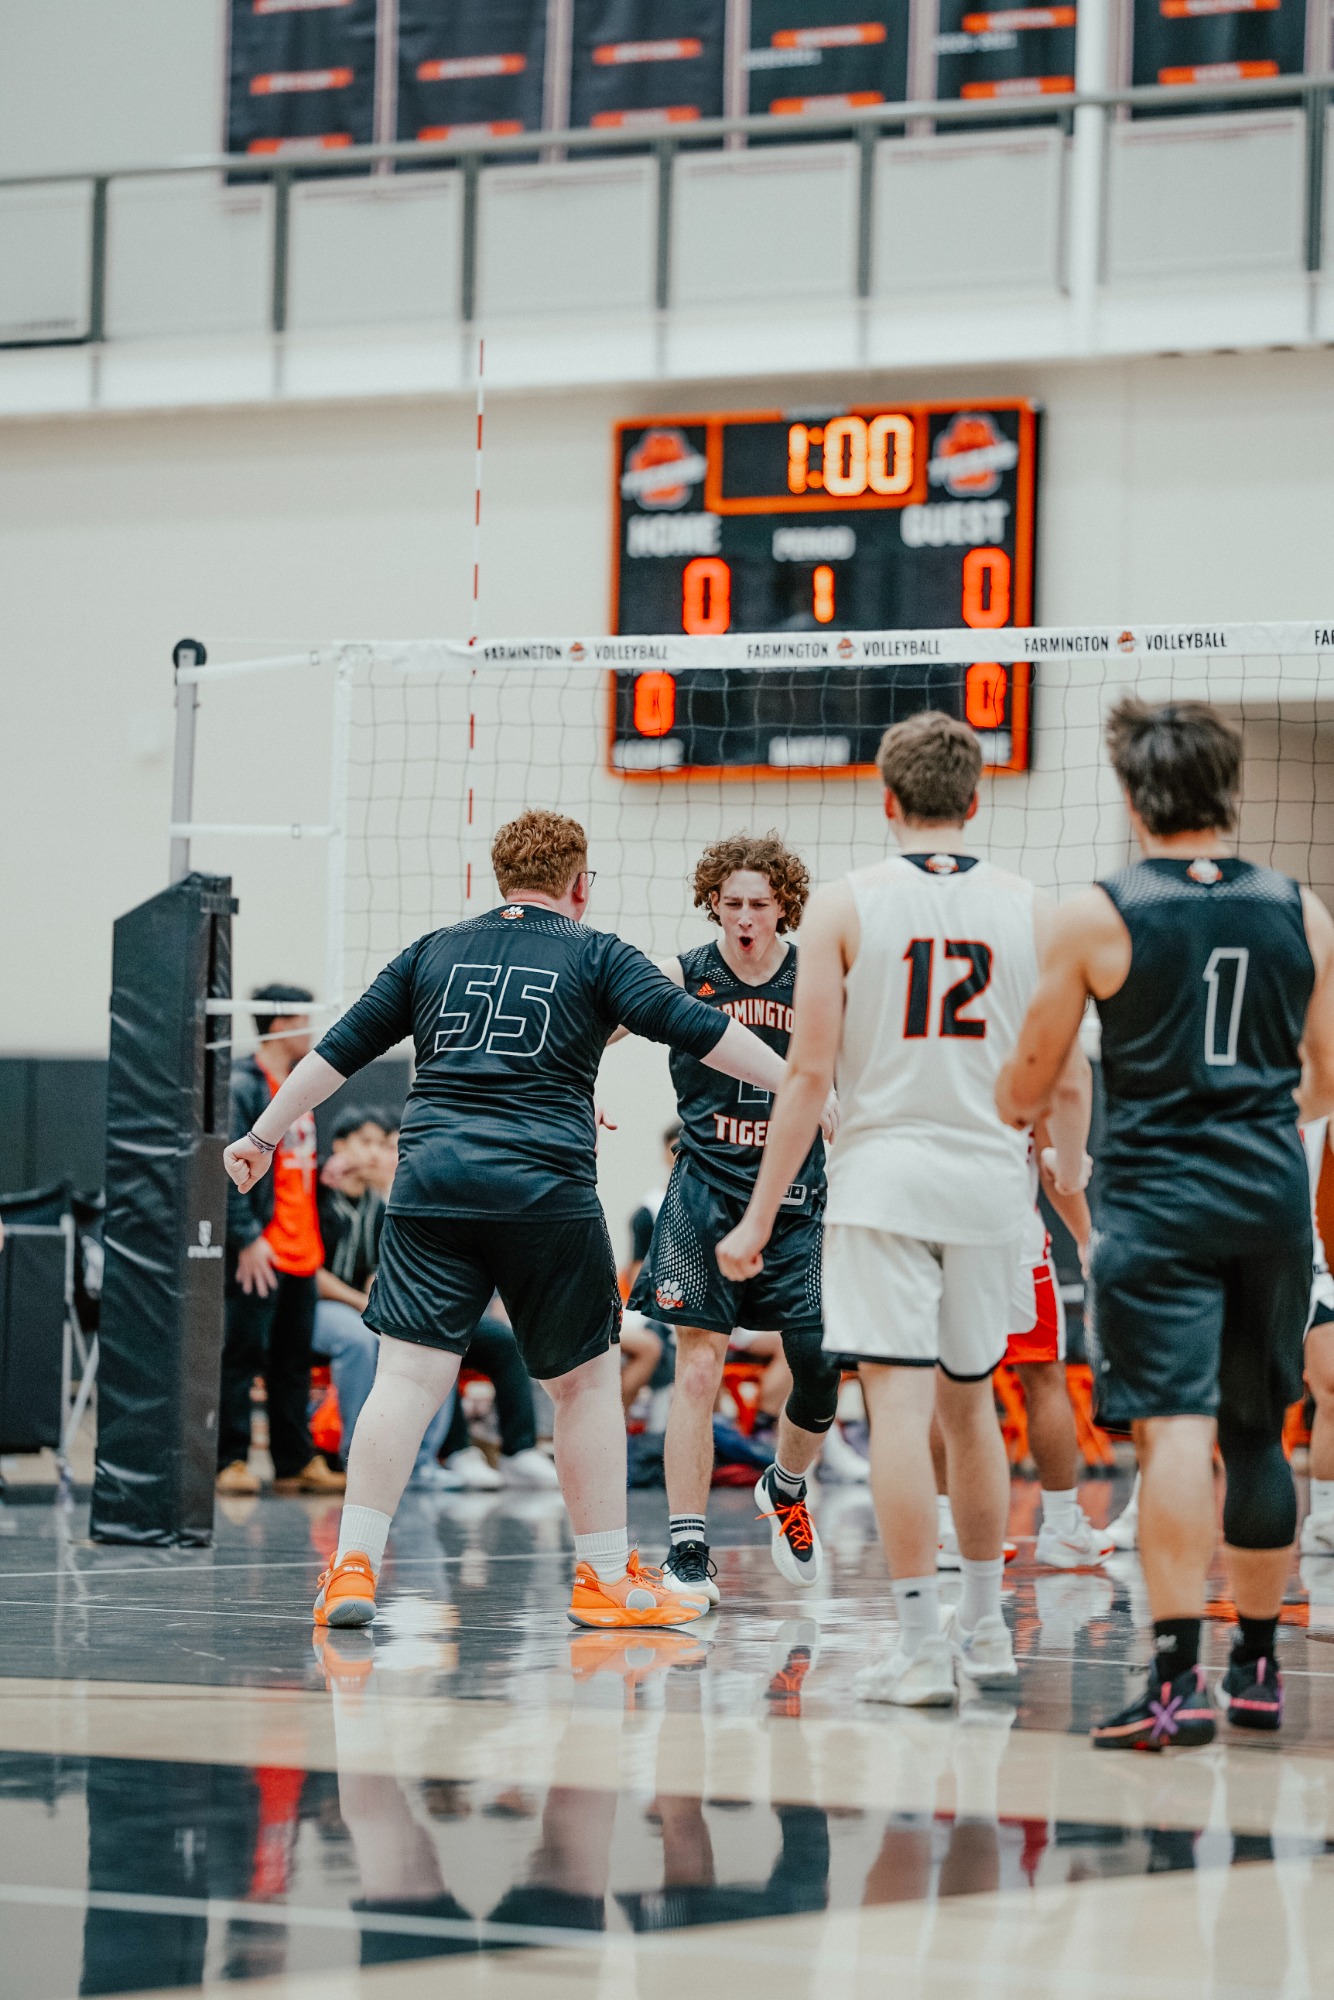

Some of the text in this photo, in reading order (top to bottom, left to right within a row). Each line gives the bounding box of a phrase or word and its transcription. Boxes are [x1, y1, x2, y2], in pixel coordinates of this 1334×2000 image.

[787, 413, 915, 497] 1:00
[626, 513, 722, 559] HOME
[900, 499, 1010, 548] GUEST
[682, 557, 731, 635] 0
[813, 565, 835, 624] 1
[962, 547, 1011, 630] 0
[484, 643, 669, 662] FARMINGTON VOLLEYBALL
[747, 639, 942, 660] FARMINGTON VOLLEYBALL
[1024, 631, 1229, 653] FARMINGTON VOLLEYBALL
[434, 963, 560, 1057] 55
[903, 937, 994, 1040] 12
[1202, 946, 1250, 1067] 1
[716, 998, 796, 1035] RMINGTO
[713, 1111, 770, 1147] TIGE
